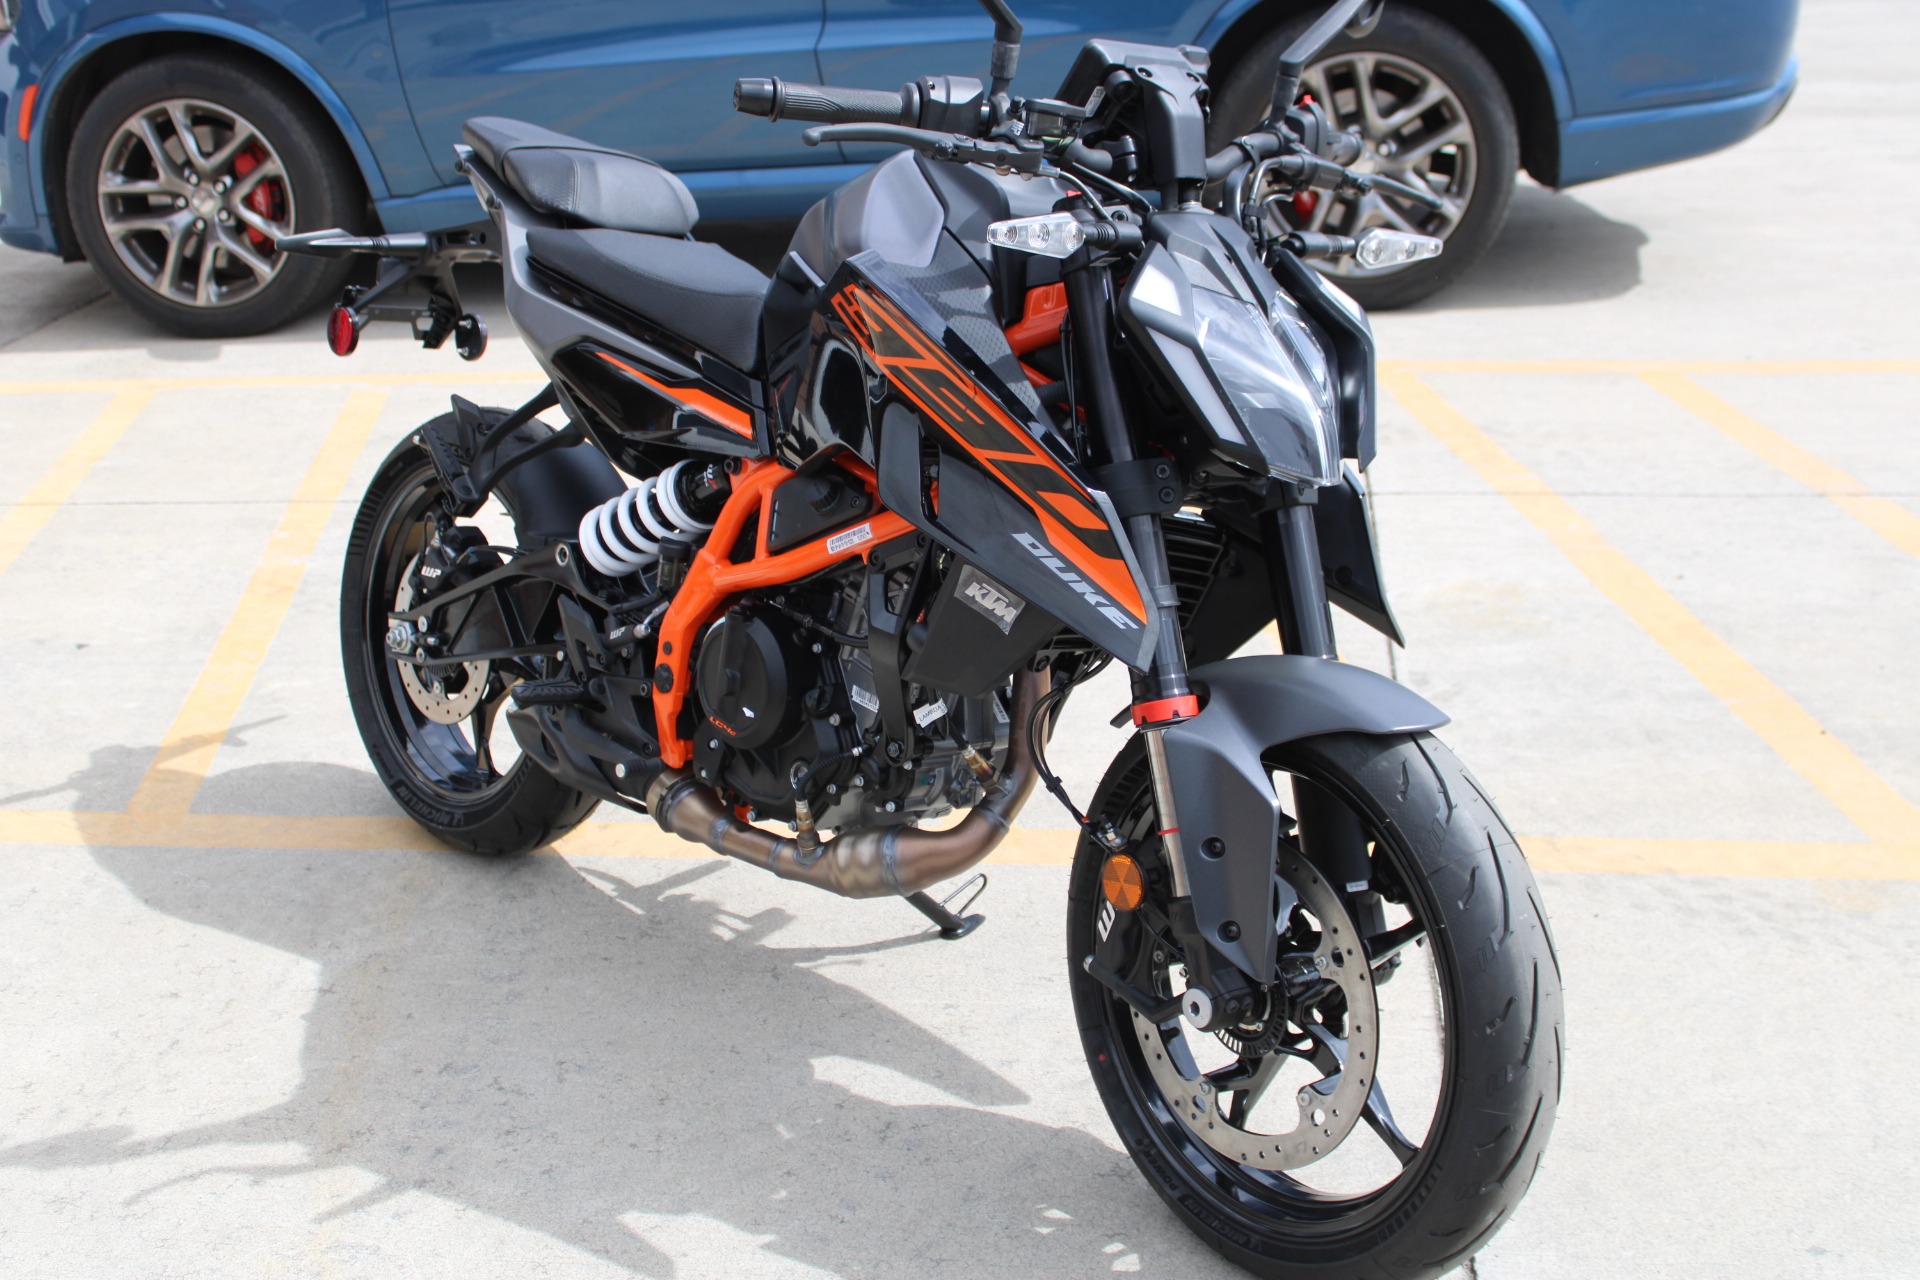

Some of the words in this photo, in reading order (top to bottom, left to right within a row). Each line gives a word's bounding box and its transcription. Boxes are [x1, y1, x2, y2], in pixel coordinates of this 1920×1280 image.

[421, 566, 441, 578] WP
[1012, 532, 1139, 630] DUKE
[965, 582, 1017, 622] KTM
[610, 626, 626, 639] WP
[918, 705, 942, 722] LAMBDA
[397, 785, 454, 825] MICHELIN
[1143, 1149, 1179, 1191] POWER
[1183, 1197, 1252, 1246] MICHELIN
